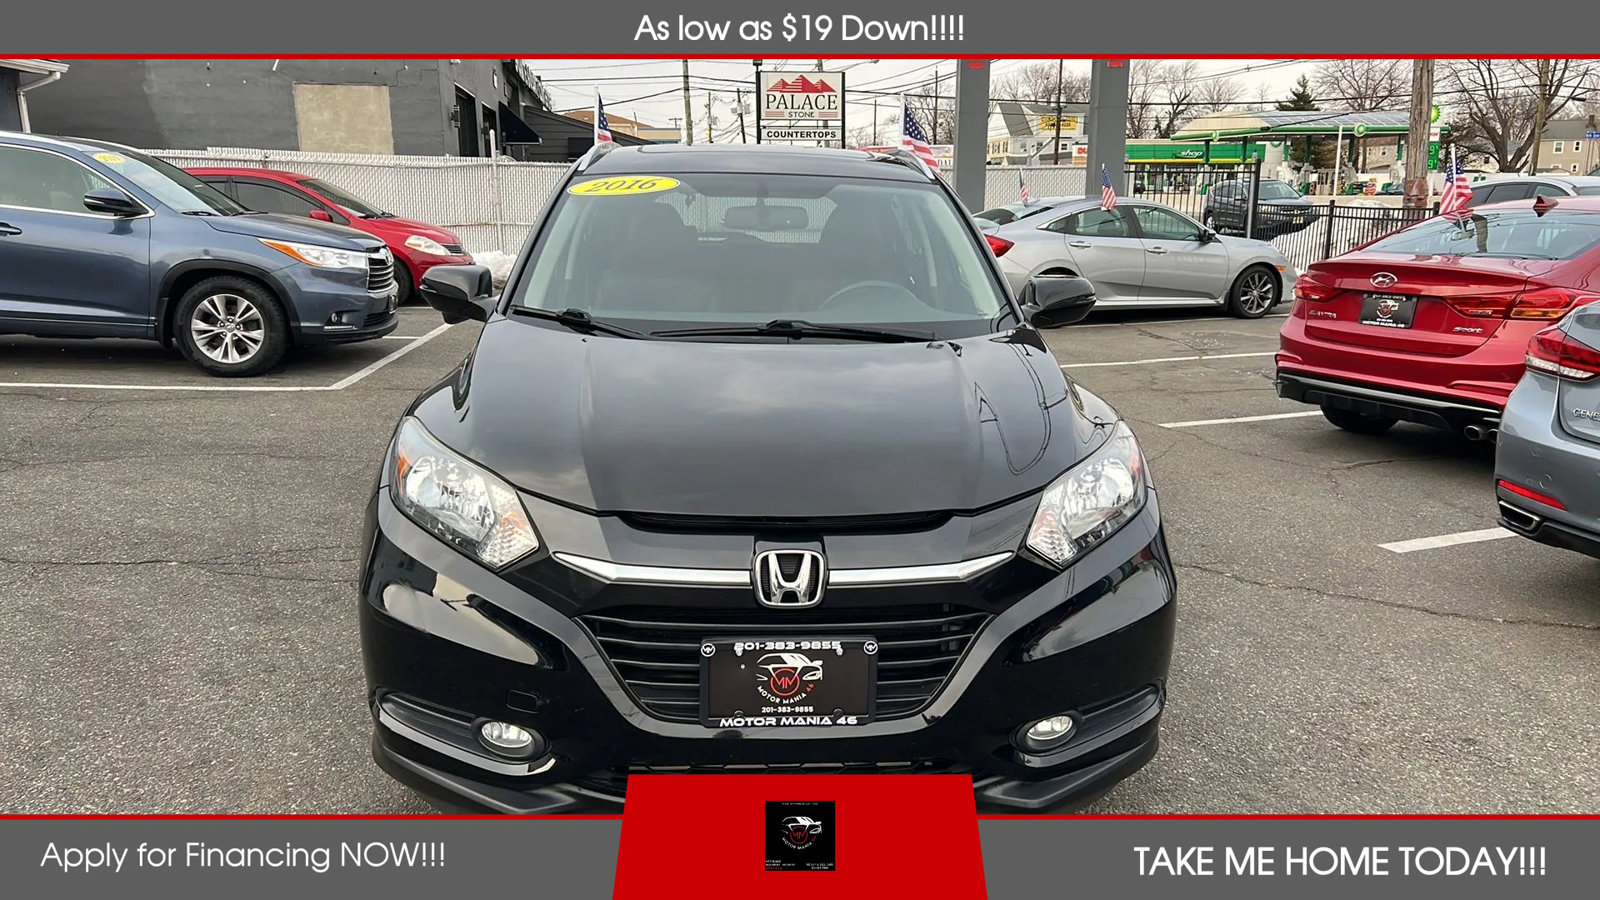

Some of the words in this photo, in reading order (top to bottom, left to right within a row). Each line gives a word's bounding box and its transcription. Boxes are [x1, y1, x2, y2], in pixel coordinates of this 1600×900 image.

[766, 94, 838, 110] PALACE
[1181, 150, 1203, 158] shop
[584, 178, 662, 193] 2016
[733, 640, 843, 651] 201-383-9855
[757, 685, 781, 704] MOTOR
[782, 692, 807, 704] MANIA
[719, 718, 777, 727] MOTOR
[780, 717, 833, 726] MANIA
[836, 717, 858, 725] 46
